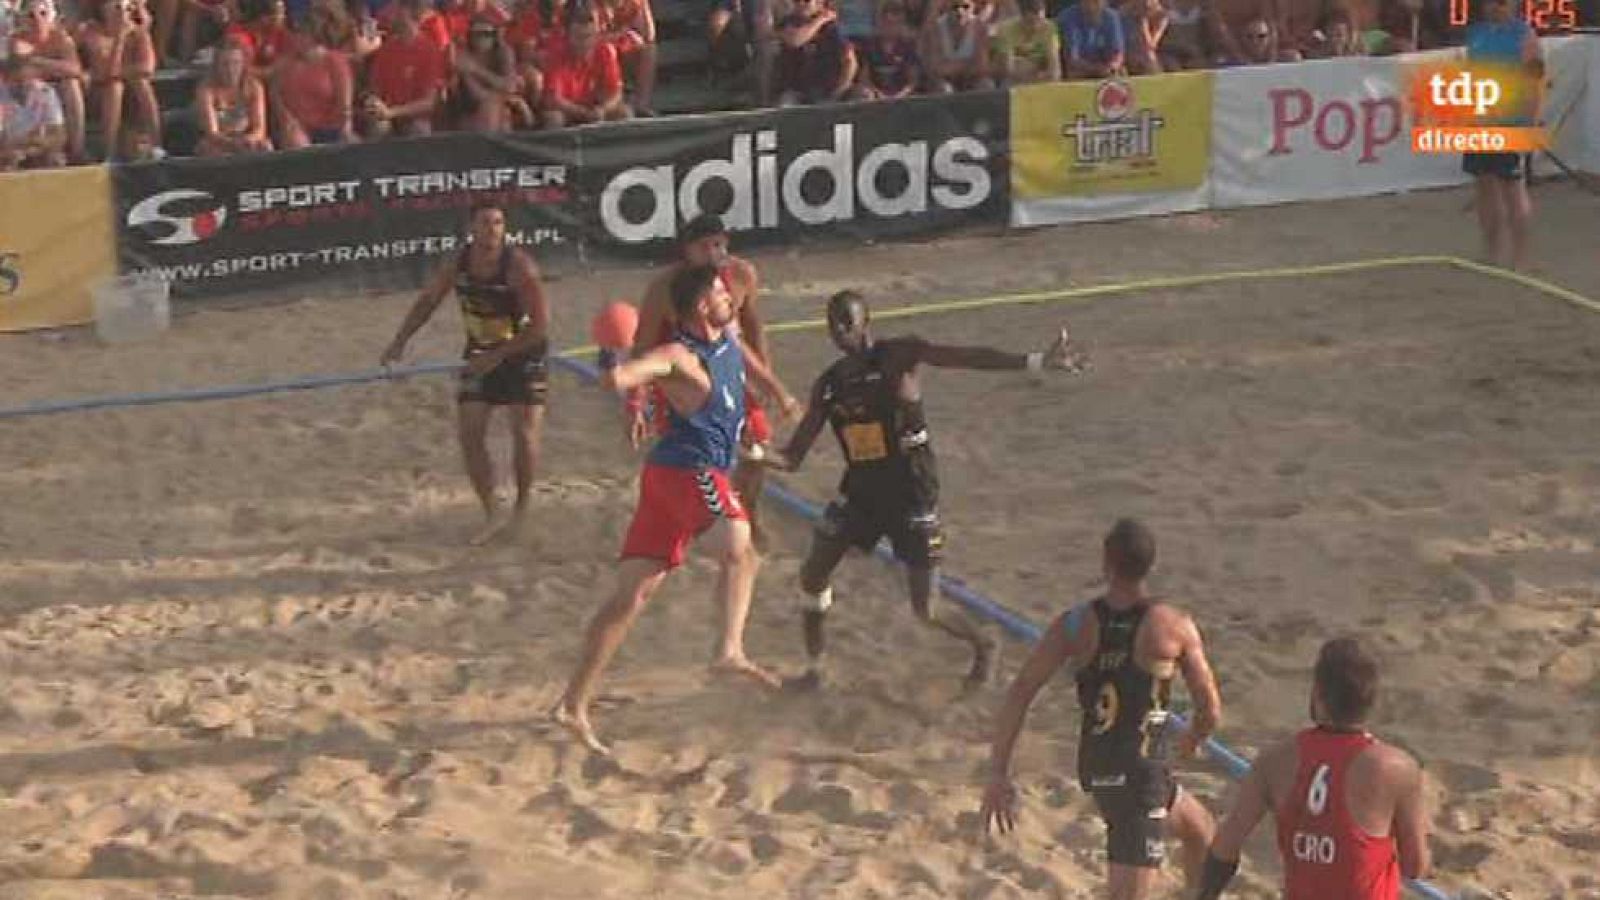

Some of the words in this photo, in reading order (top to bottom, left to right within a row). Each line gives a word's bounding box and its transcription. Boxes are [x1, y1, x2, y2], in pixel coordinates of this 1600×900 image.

[238, 180, 361, 212] SPORT
[373, 165, 567, 199] TRANSFER
[600, 123, 993, 242] adidas
[1307, 763, 1331, 816] 6
[1292, 833, 1335, 864] CRO
